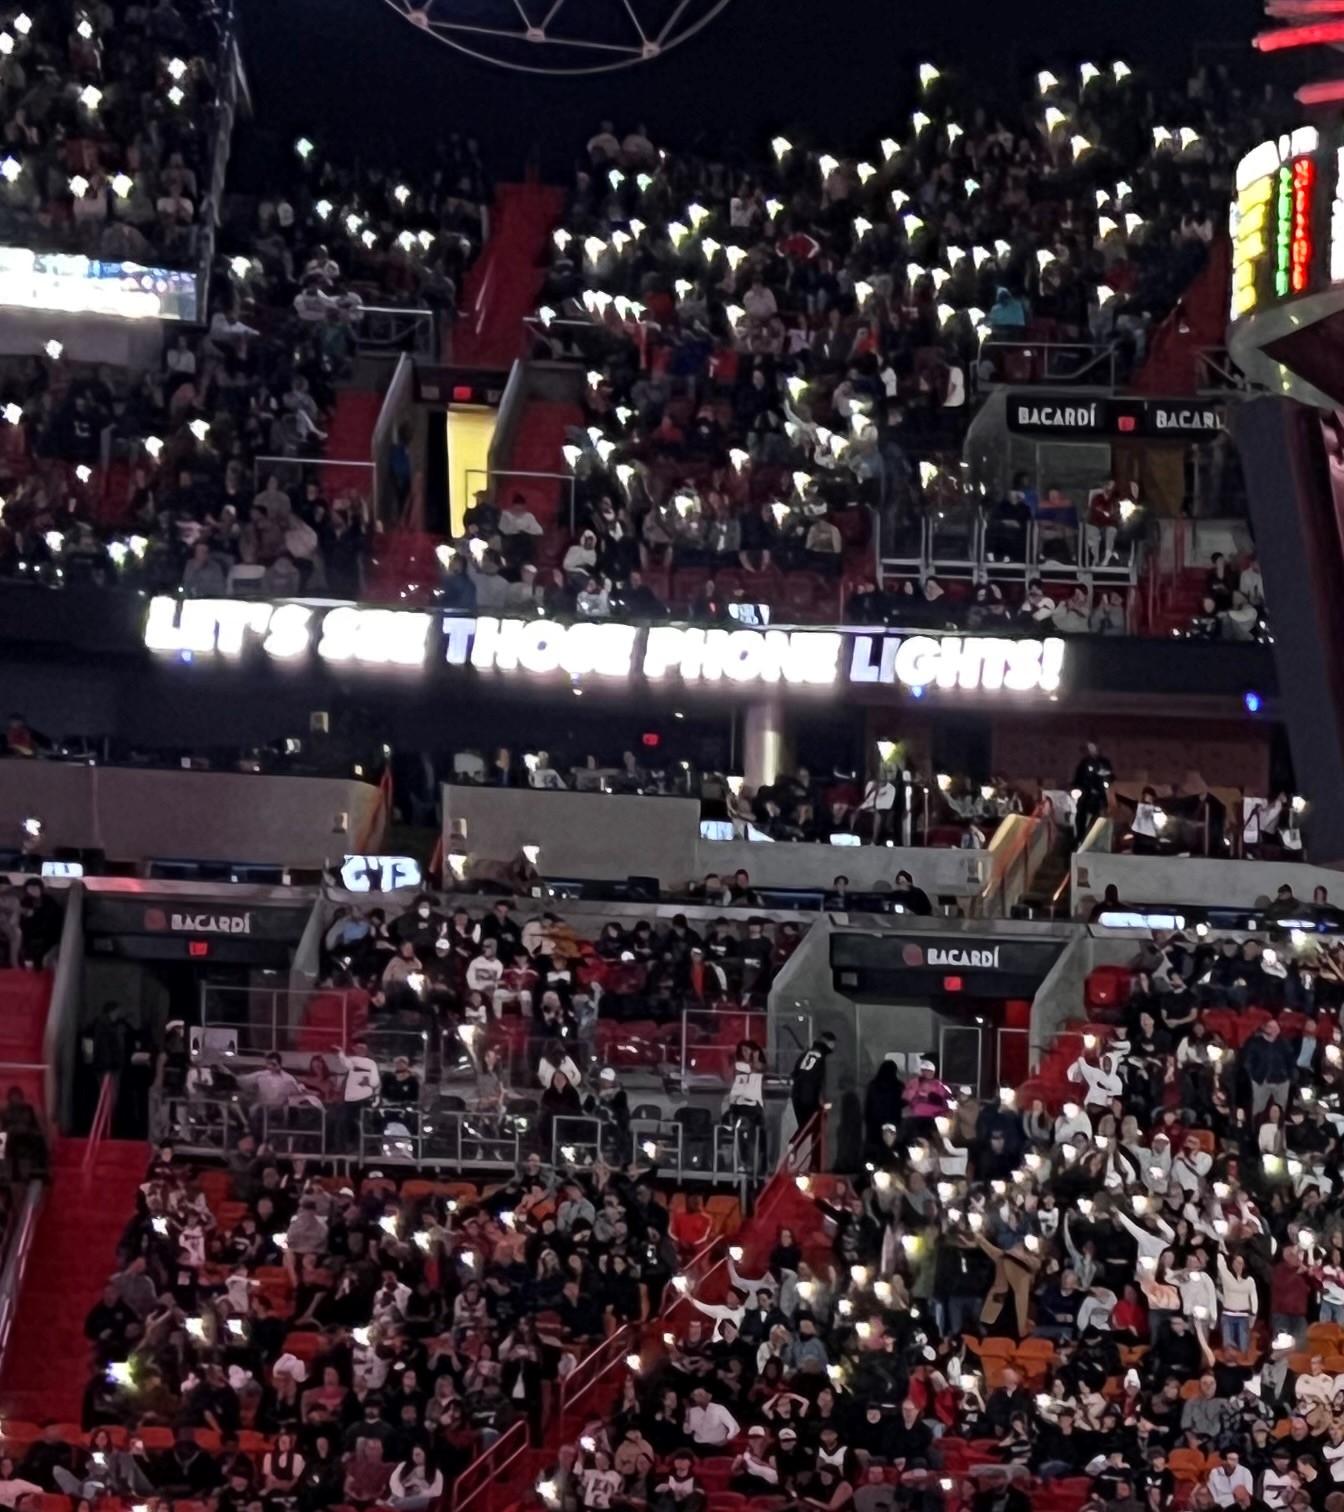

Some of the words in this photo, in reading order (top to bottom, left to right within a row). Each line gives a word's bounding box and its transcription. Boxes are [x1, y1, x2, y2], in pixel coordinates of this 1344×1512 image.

[1018, 403, 1097, 428] BACARDÍ
[1156, 409, 1224, 430] BACAR
[145, 596, 311, 657] LET'S
[319, 605, 432, 665] SEE
[443, 616, 637, 676] THOSE
[643, 625, 842, 684] PHONE
[850, 635, 1066, 692] LIGHTS!
[171, 913, 250, 934] BACARDÍ
[927, 945, 999, 969] BACARDÍ
